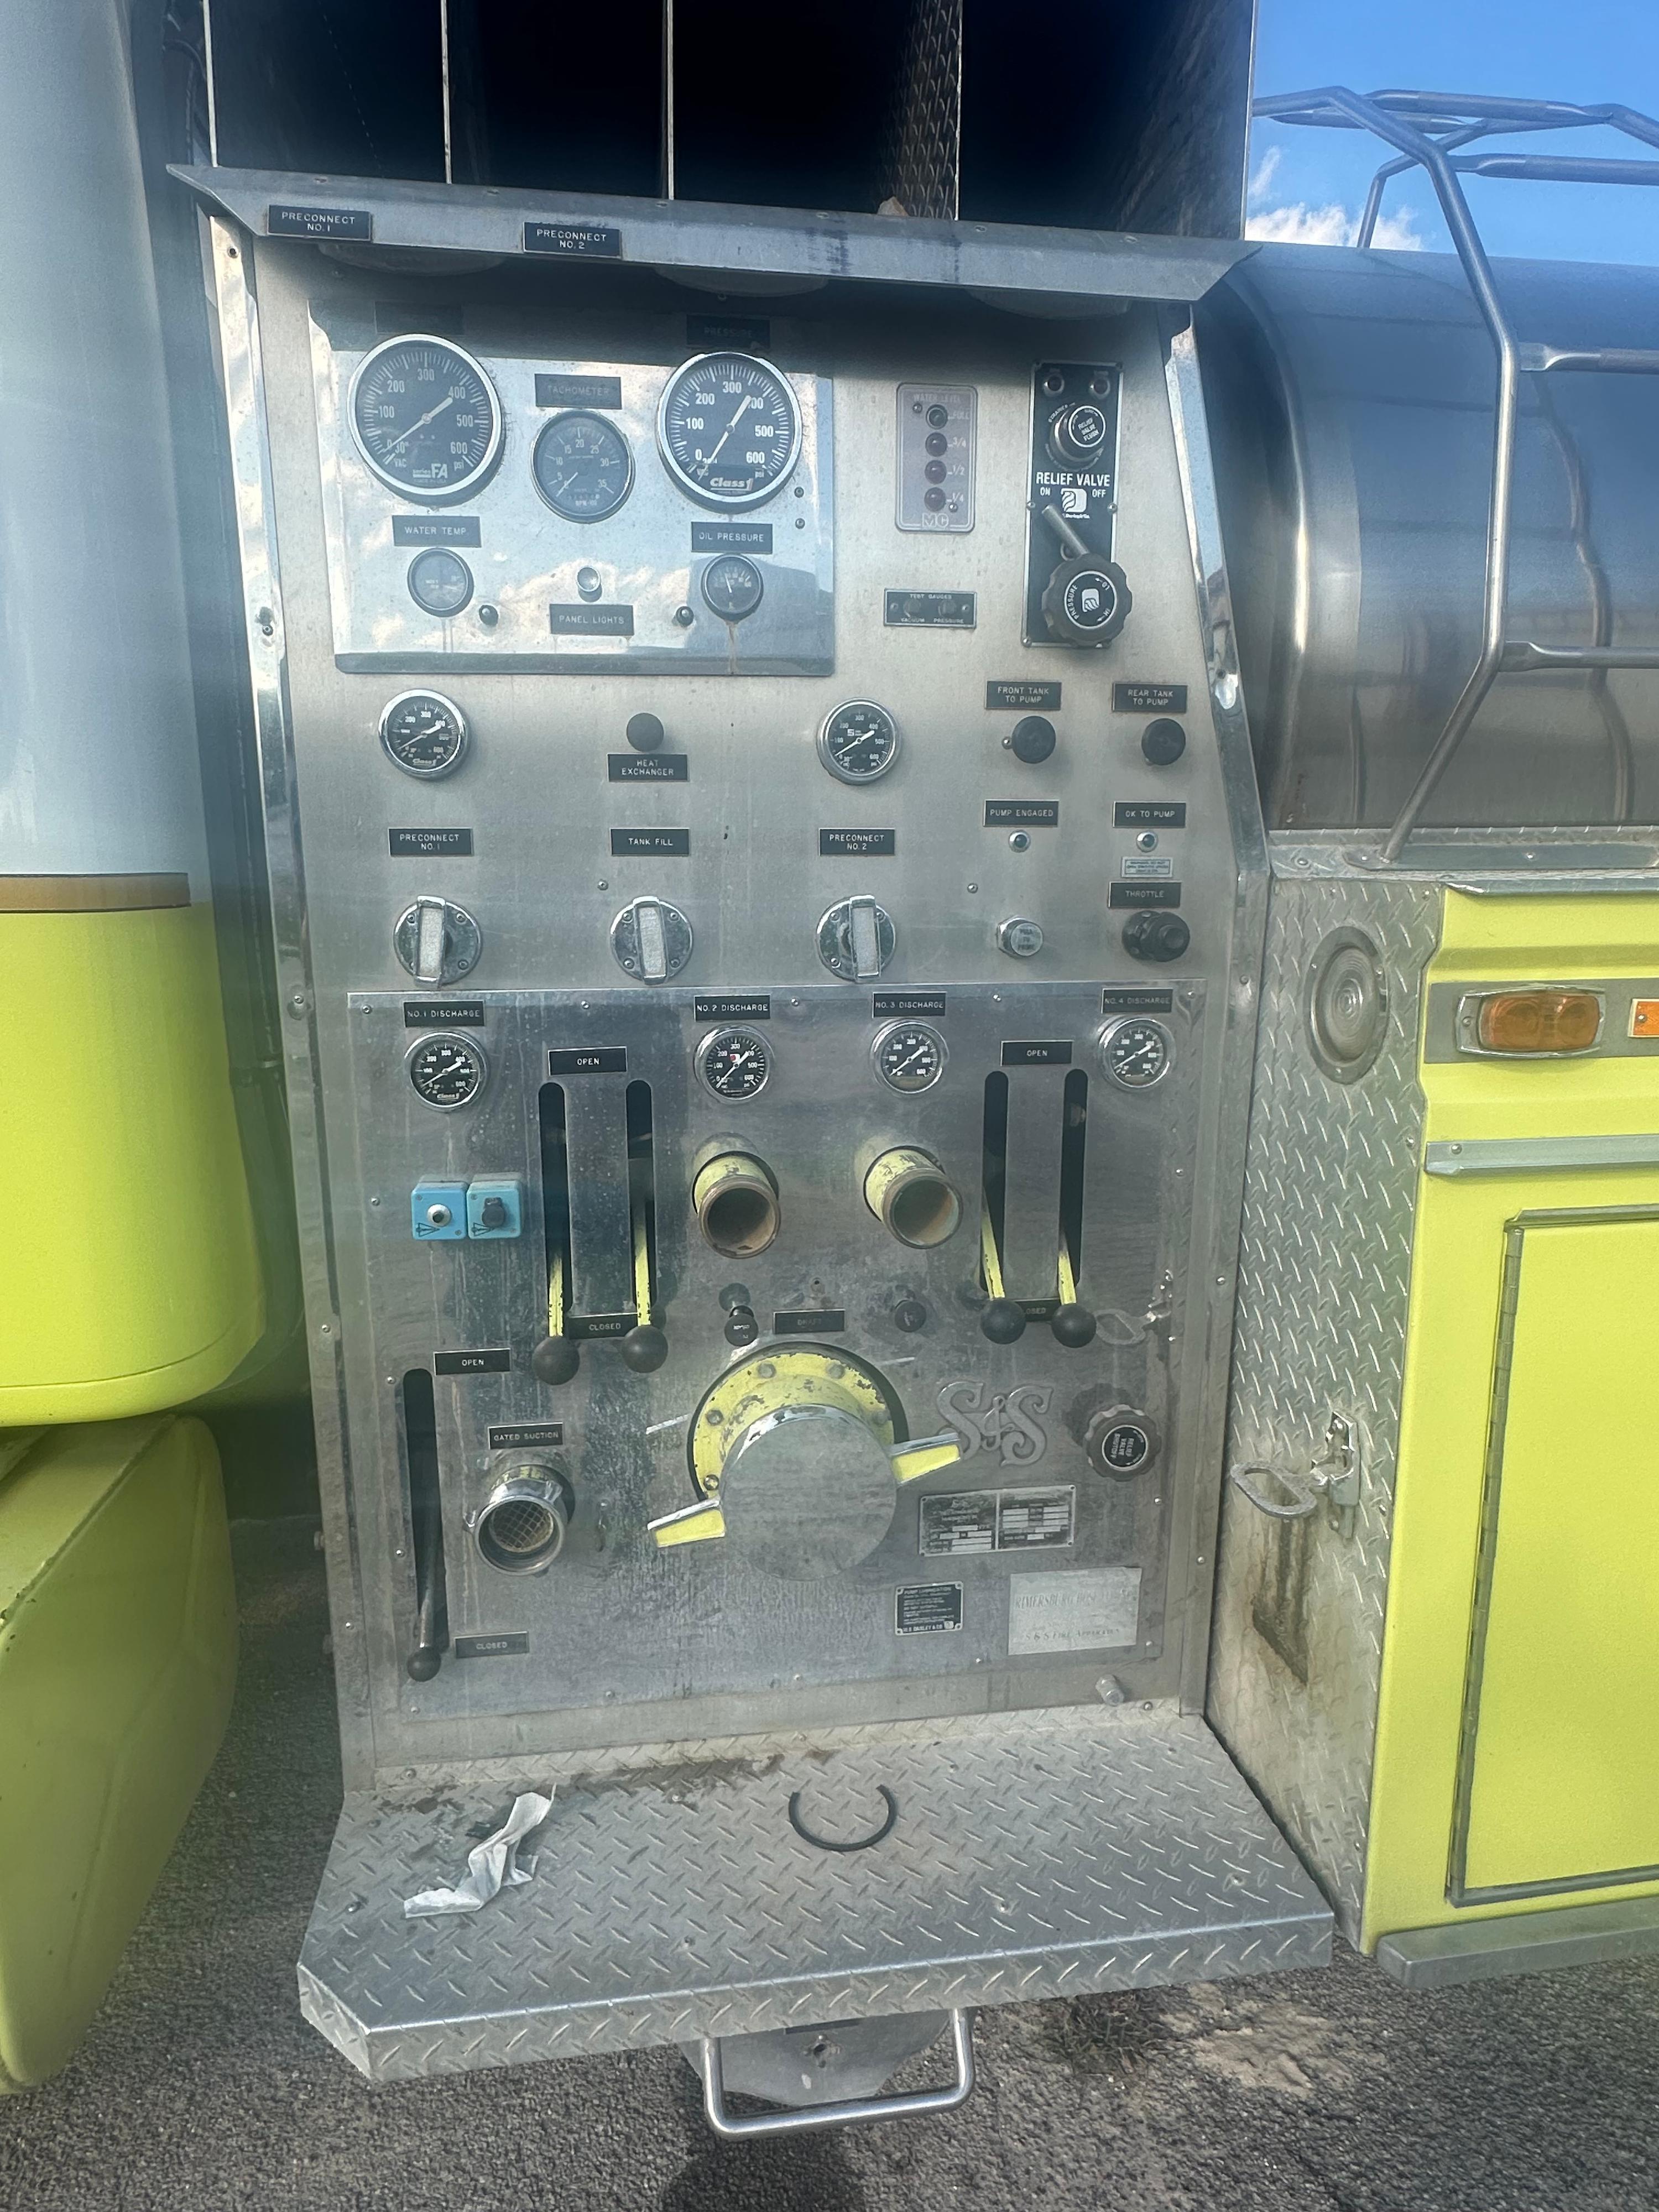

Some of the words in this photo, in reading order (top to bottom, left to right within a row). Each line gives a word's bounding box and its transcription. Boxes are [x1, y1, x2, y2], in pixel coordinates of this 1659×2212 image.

[281, 212, 356, 225] PRECONNECT
[536, 228, 607, 242] PRECONNECT
[417, 368, 435, 380] 300
[387, 380, 405, 393] 200
[547, 385, 609, 397] TACHOMETER
[723, 381, 742, 394] 300
[448, 387, 466, 399] 400
[696, 393, 715, 405] 200
[378, 405, 395, 418] 100
[456, 415, 473, 427] 500
[686, 418, 705, 430] 100
[755, 425, 774, 438] 500
[450, 442, 467, 454] 600
[575, 439, 585, 448] 20
[564, 445, 572, 455] 15
[589, 445, 599, 455] 25
[695, 448, 702, 461] 0
[556, 456, 564, 466] 10
[600, 457, 610, 467] 30
[747, 451, 765, 464] 600
[952, 464, 965, 476] 1/2
[598, 479, 607, 488] 35
[1035, 471, 1073, 485] RELIEF
[1076, 473, 1111, 487] VALVE
[1040, 487, 1051, 497] ON
[1092, 489, 1107, 498] OFF
[952, 492, 964, 503] 1/4
[404, 526, 437, 535] WATER
[442, 526, 467, 536] TEMP
[698, 532, 713, 541] OIL
[717, 533, 765, 542] PRESSURE
[1067, 584, 1079, 620] PRESSURE
[559, 614, 589, 624] PANEL
[592, 615, 625, 625] LIGHTS
[997, 686, 1025, 695] FRONT
[1027, 686, 1050, 695] TANK
[1128, 688, 1150, 697] REAR
[1152, 689, 1174, 698] TANK
[1005, 695, 1016, 703] TO
[1019, 695, 1042, 704] PUMP
[1133, 697, 1144, 706] TO
[1146, 698, 1169, 706] PUMP
[637, 759, 659, 767] HEAT
[621, 768, 675, 776] EXCHANGER
[989, 809, 1013, 817] PUMP
[399, 833, 460, 842] PRECONNECT
[628, 837, 651, 846] TANK
[655, 838, 674, 846] FILL
[829, 834, 885, 842] PRECONNECT
[1125, 890, 1165, 898] THROTTLE
[431, 1009, 480, 1018] DISCHARGE
[577, 1057, 600, 1066] OPEN
[588, 1323, 622, 1331] CLOSED
[493, 1433, 521, 1441] GATED
[523, 1431, 559, 1441] SUCTION
[475, 1641, 508, 1650] CLOSED
